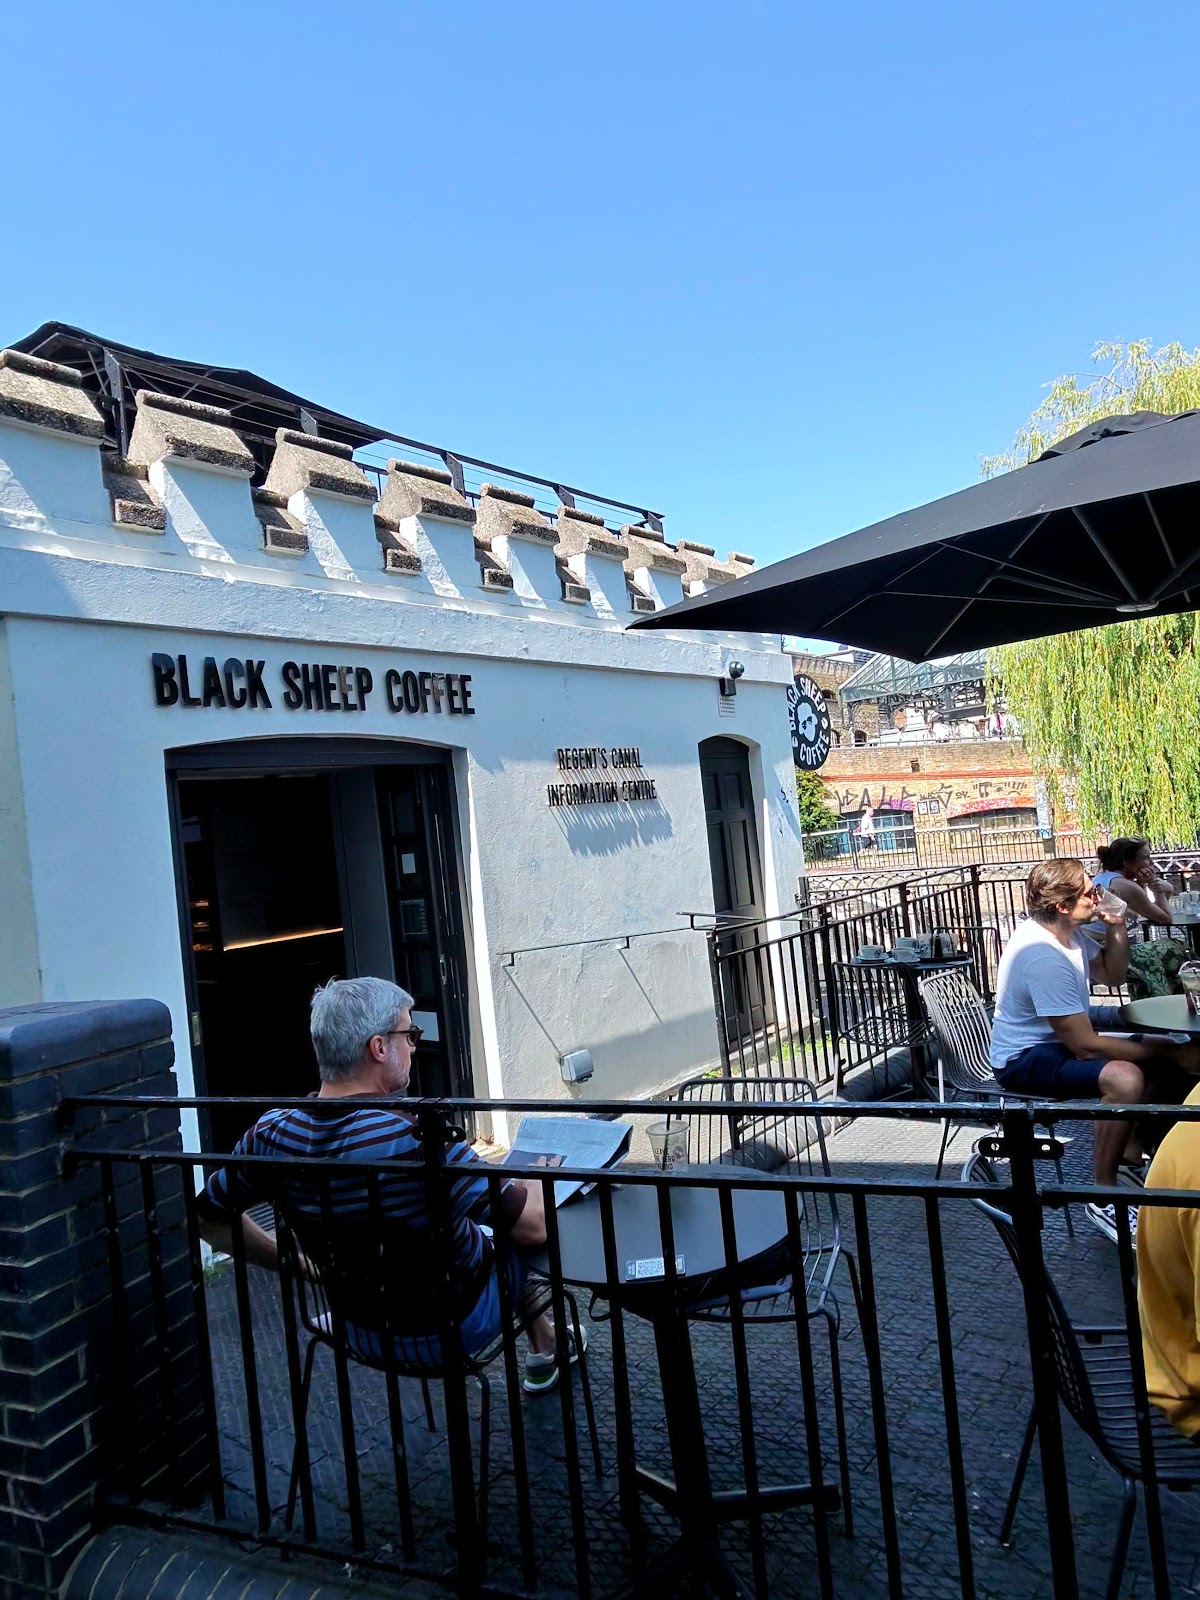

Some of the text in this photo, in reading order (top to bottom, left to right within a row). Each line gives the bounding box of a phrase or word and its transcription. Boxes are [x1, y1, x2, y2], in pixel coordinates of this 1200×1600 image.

[152, 653, 476, 715] BLACK SHEEP COFFEE
[800, 677, 827, 713] SHEEP
[557, 748, 643, 770] REGENT'S CANAL
[800, 730, 829, 766] COFFEE
[547, 780, 657, 806] INFORMATION CENTRE
